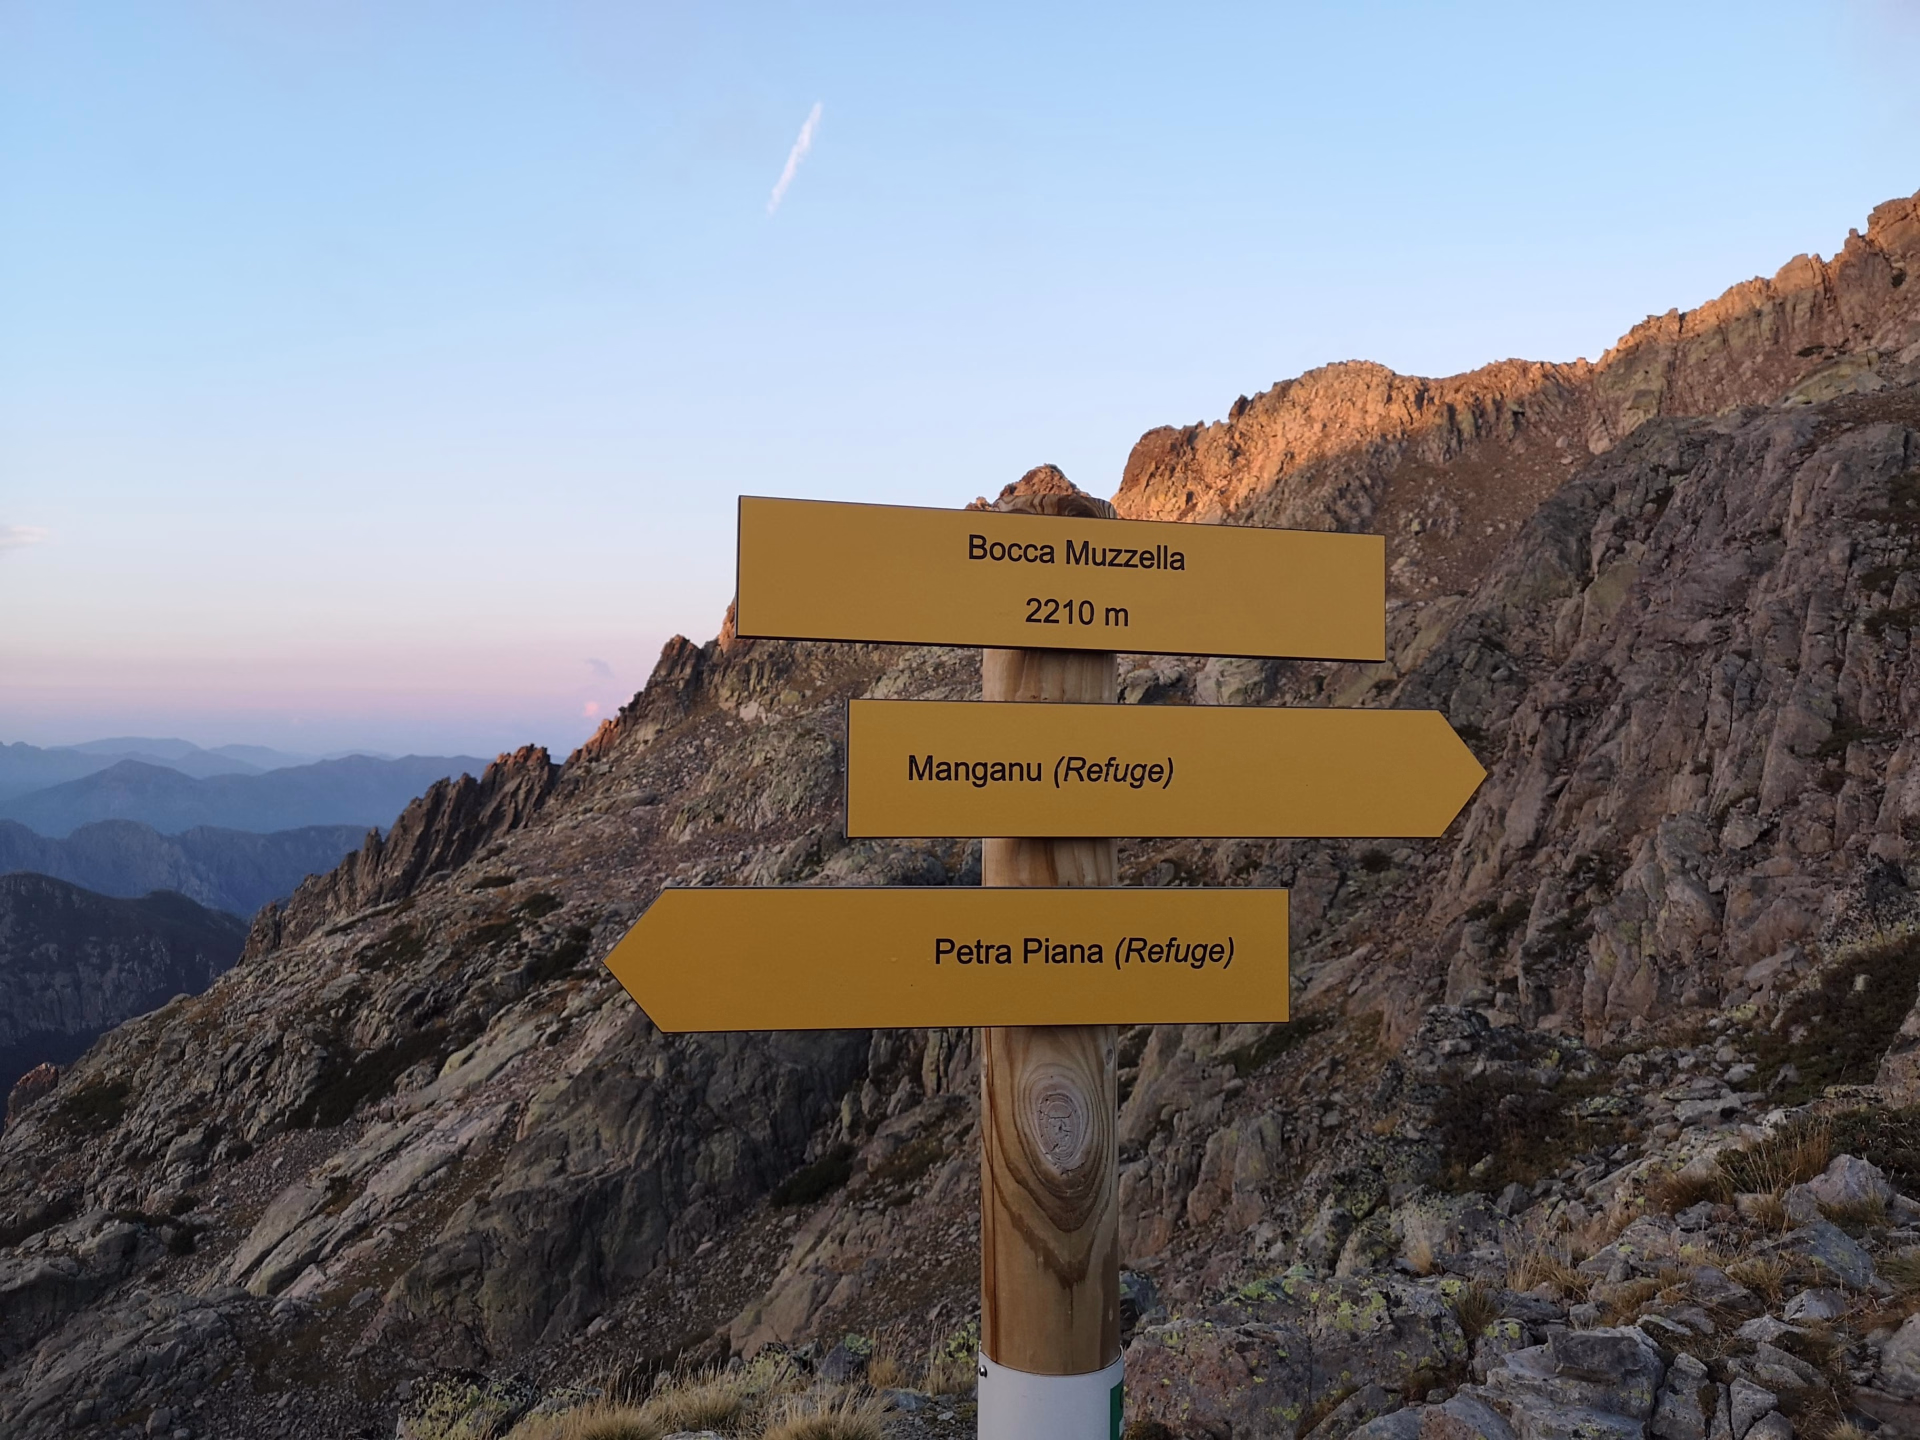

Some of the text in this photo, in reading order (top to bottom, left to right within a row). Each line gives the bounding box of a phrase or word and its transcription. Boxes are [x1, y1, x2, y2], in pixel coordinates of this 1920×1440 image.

[968, 533, 1186, 571] Bocca Muzzella
[1025, 597, 1129, 627] 2210 m
[908, 754, 1174, 790] Manganu (Refuge)
[935, 936, 1235, 971] Petra Piana (Refuge)
